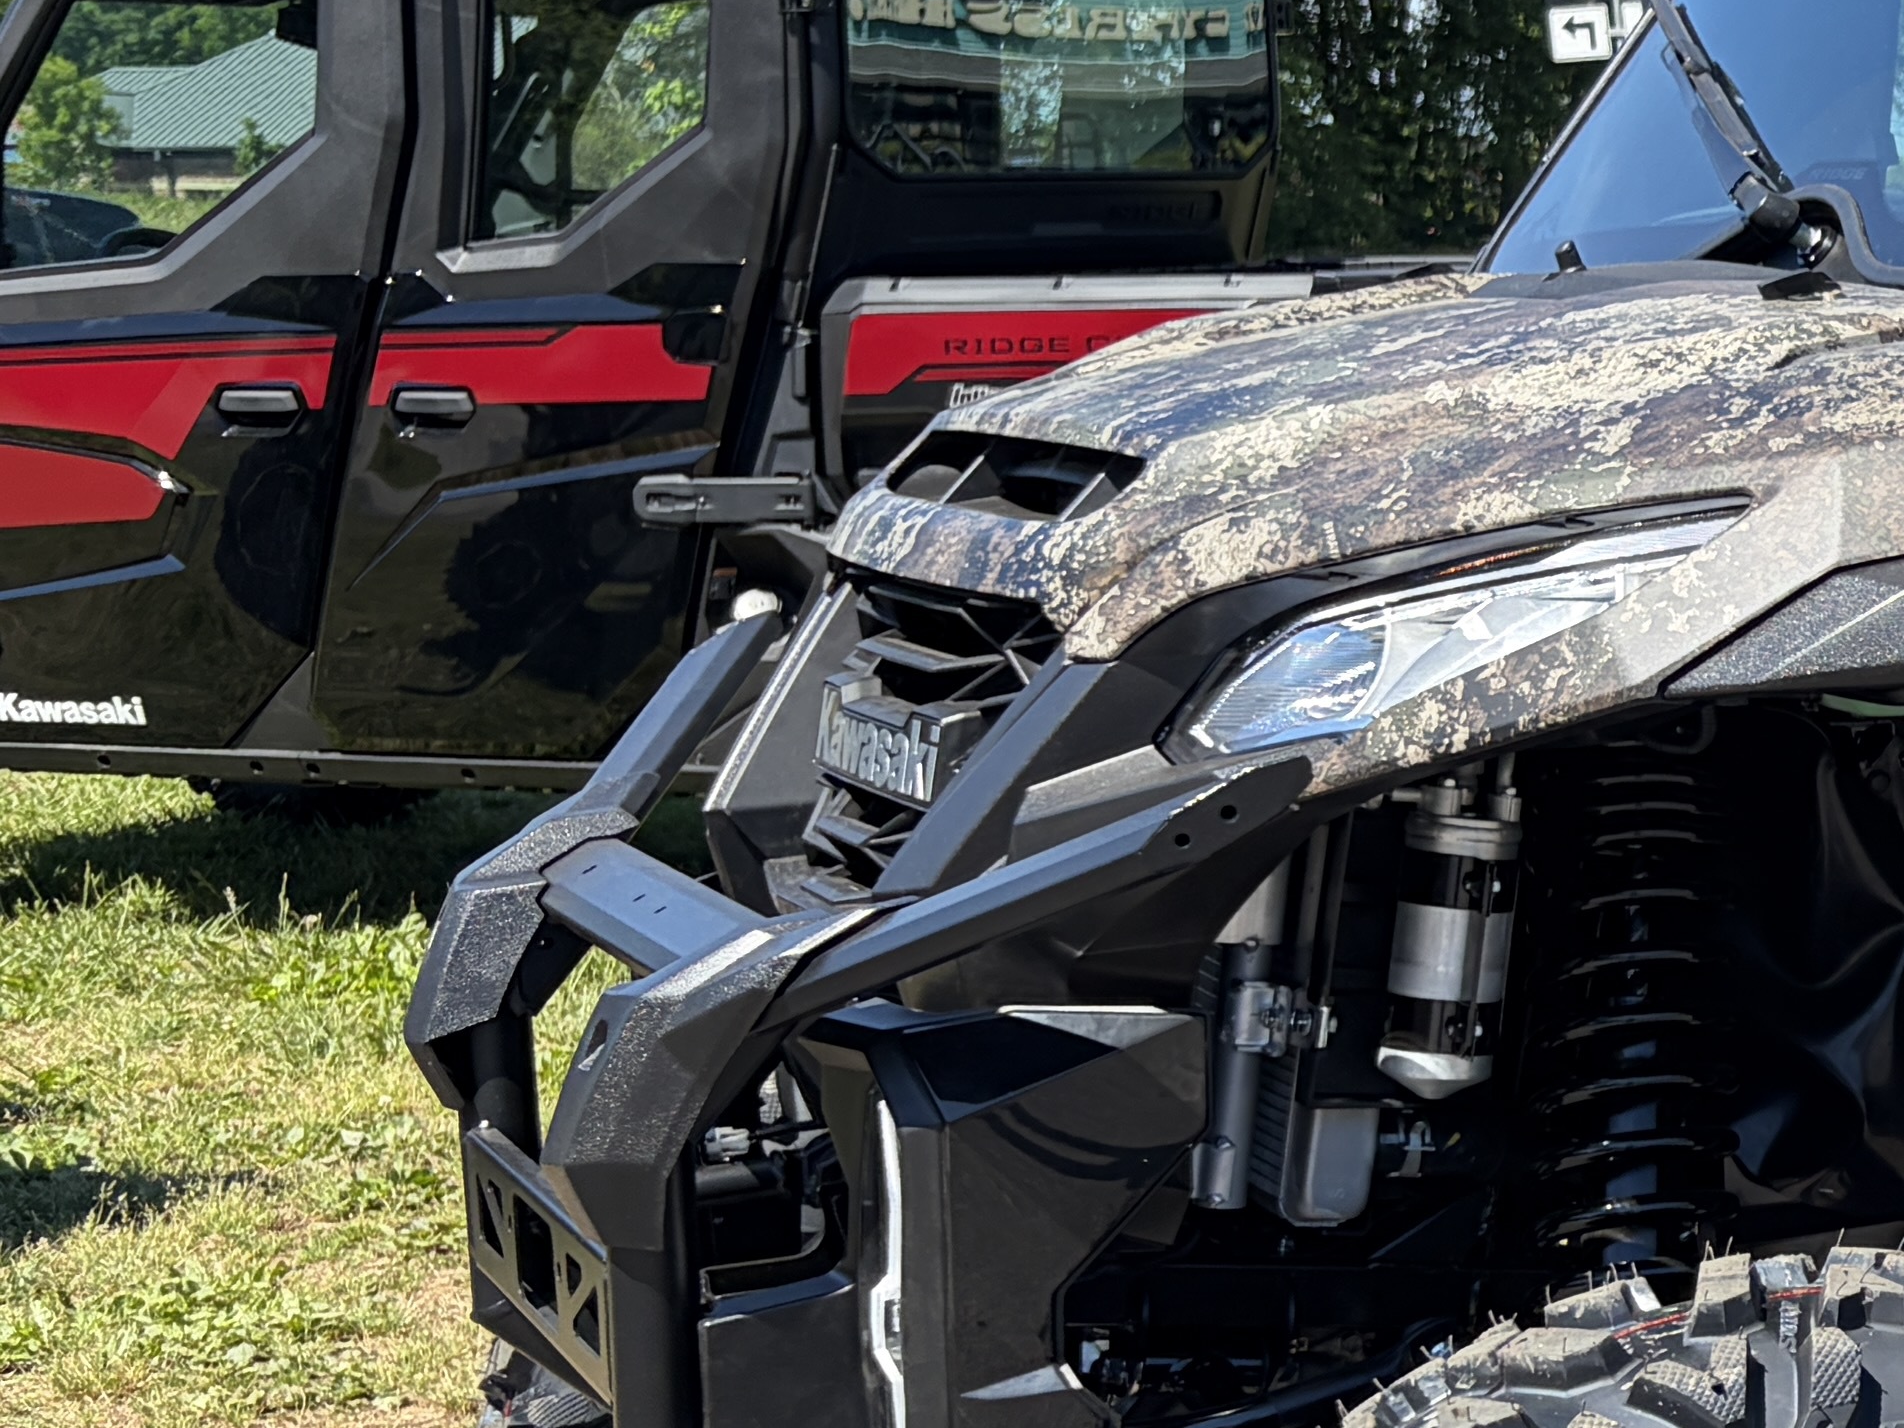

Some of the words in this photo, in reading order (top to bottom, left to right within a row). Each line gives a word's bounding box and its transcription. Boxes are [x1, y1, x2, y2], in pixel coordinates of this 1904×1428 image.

[944, 336, 1070, 356] RIDGE
[0, 691, 148, 726] Kawasaki
[815, 687, 941, 802] Kawasaki
